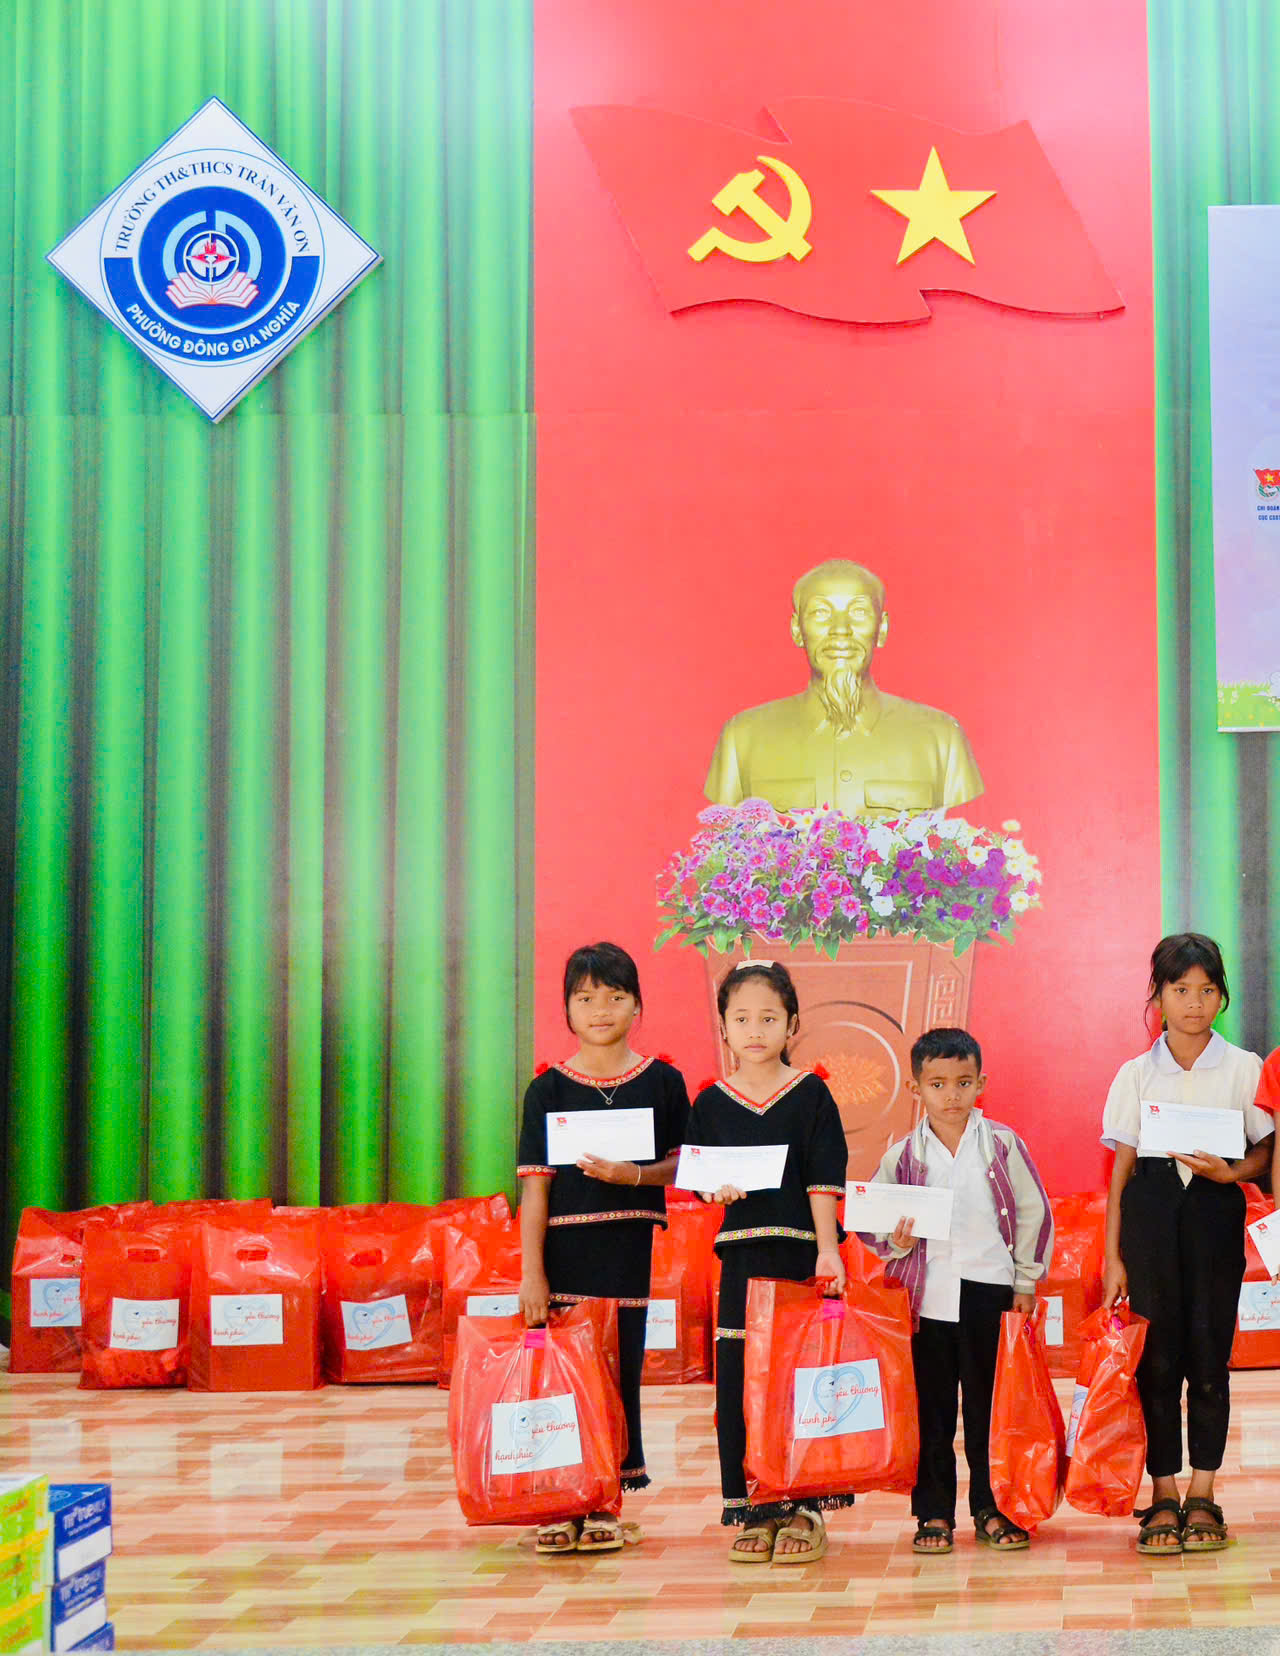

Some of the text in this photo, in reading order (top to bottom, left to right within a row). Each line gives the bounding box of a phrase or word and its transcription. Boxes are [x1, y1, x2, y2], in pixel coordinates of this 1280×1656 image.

[115, 188, 157, 251] TRƯỜNG
[154, 161, 233, 192] TH&THCS
[126, 301, 300, 355] PHƯỜNG ĐÔNG GIA NGHĨA
